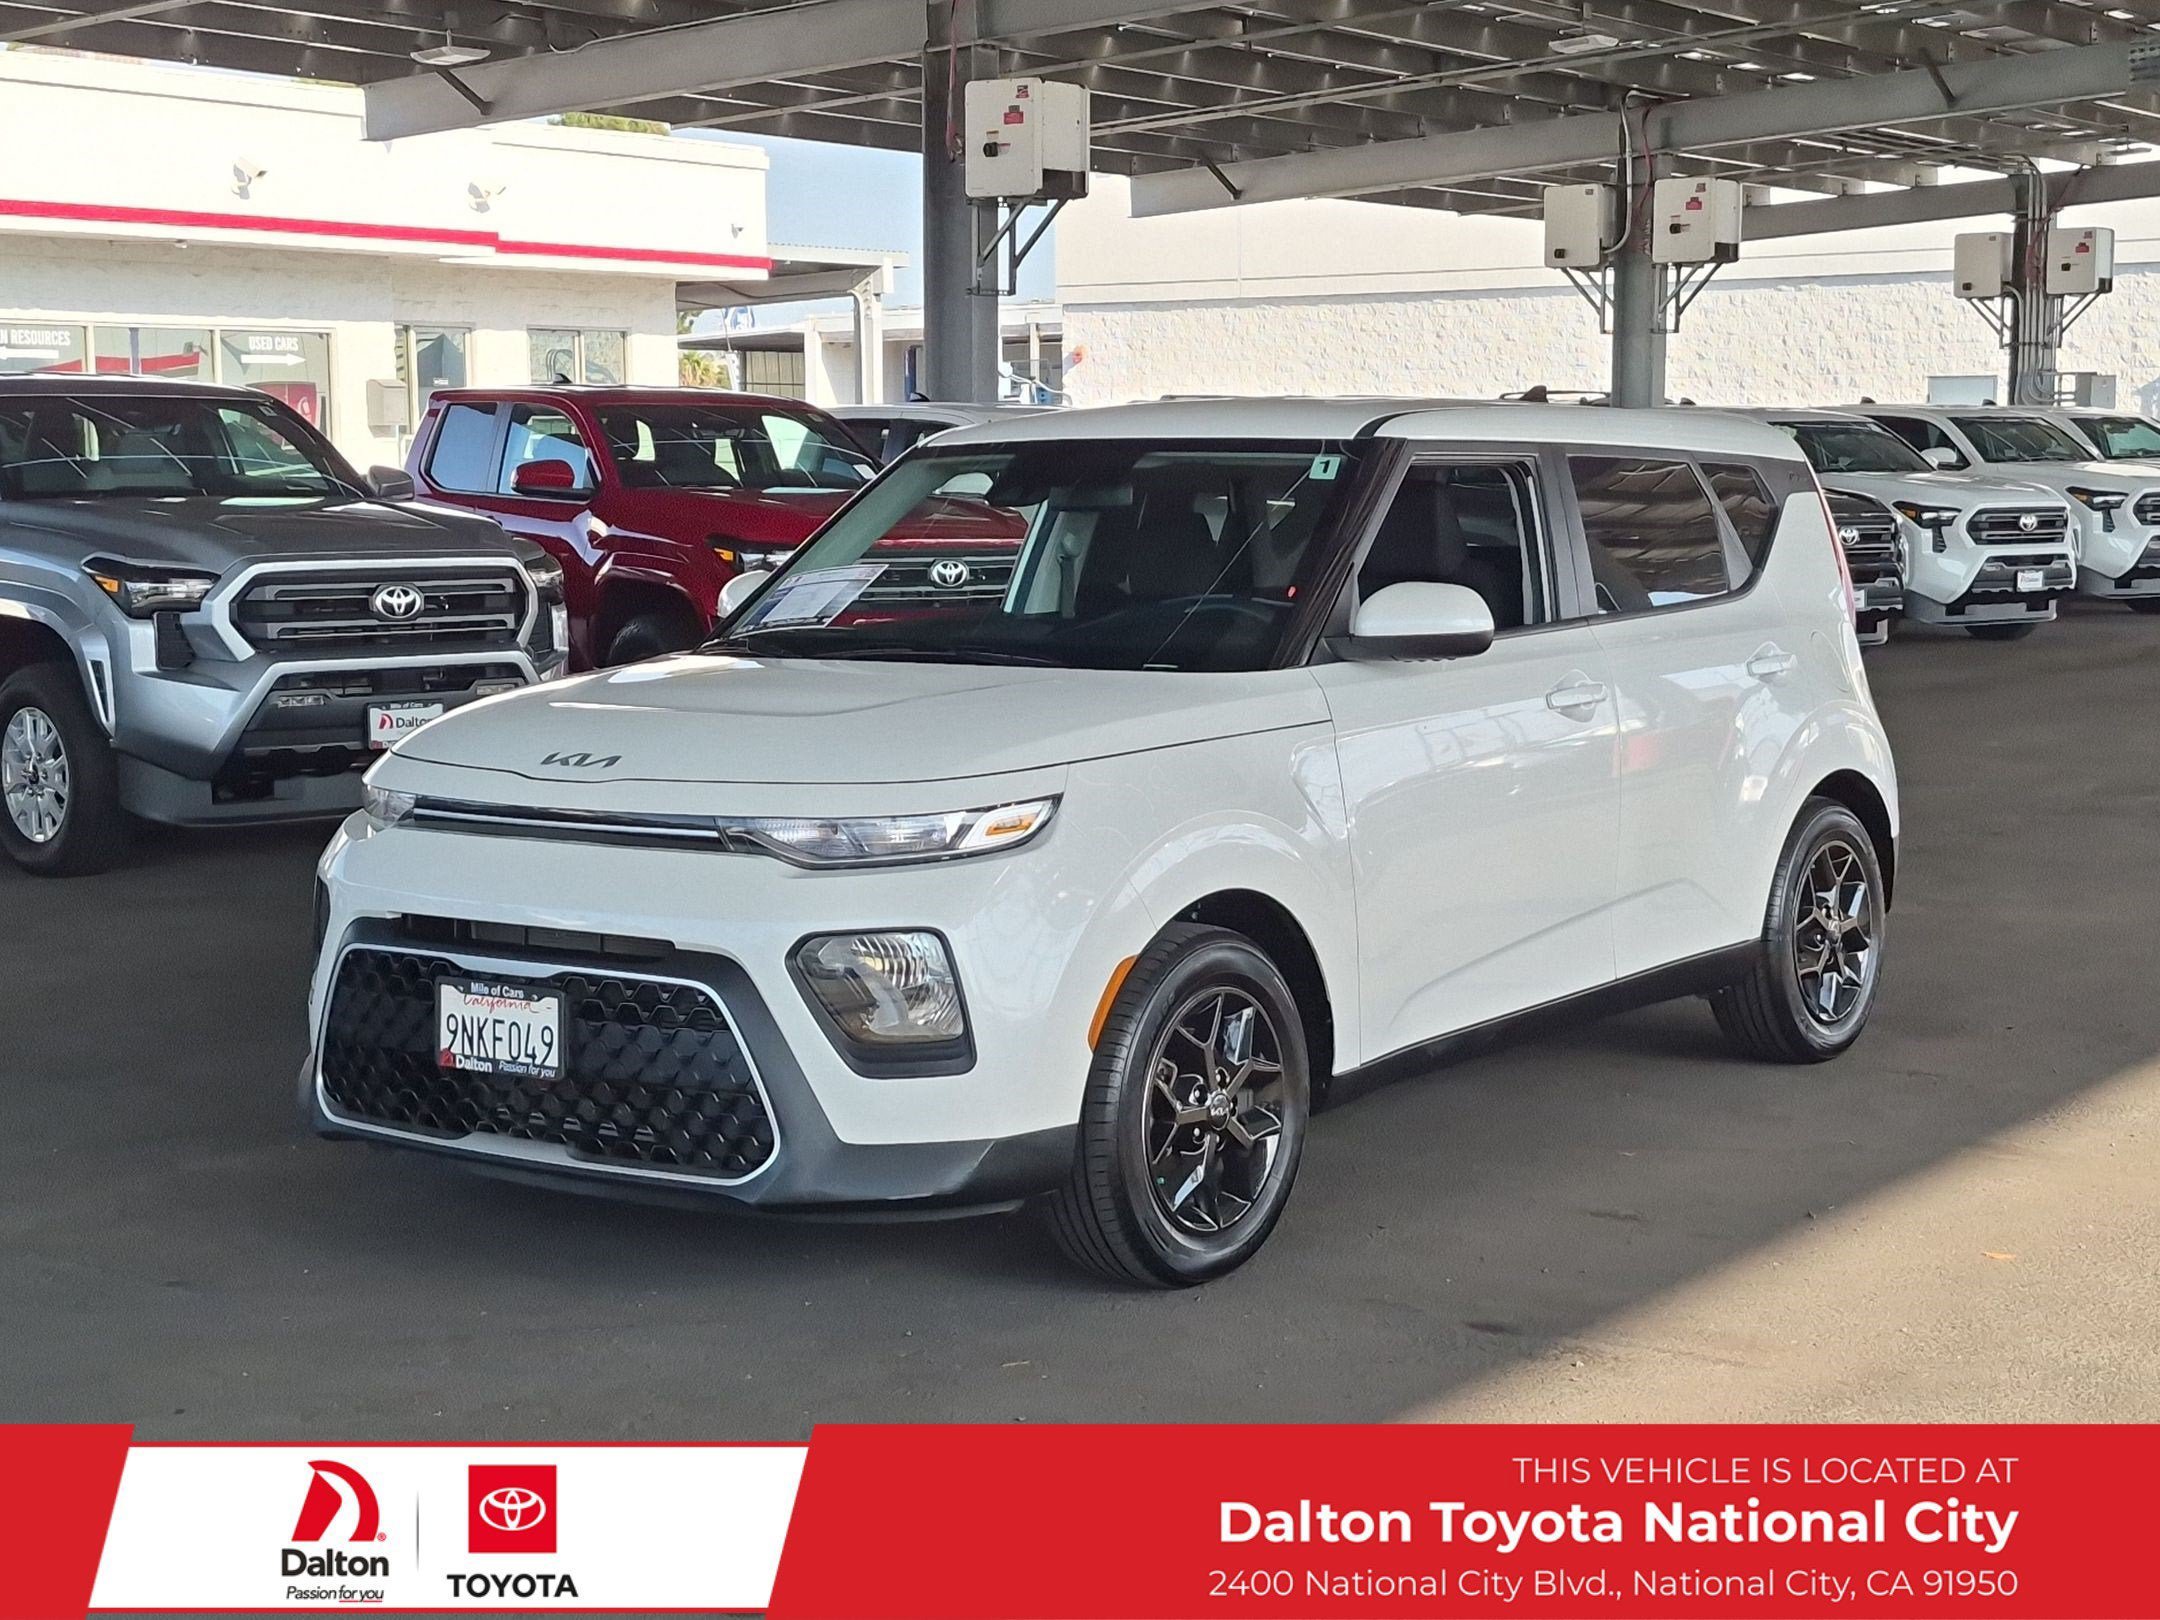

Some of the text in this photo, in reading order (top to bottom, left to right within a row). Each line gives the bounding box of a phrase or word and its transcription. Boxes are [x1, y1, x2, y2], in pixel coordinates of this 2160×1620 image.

[10, 328, 71, 346] RESOURCES
[248, 335, 299, 352] USED CARS
[1319, 459, 1331, 474] 1
[540, 751, 622, 768] KIA
[470, 981, 525, 999] Mile of Cars
[446, 1013, 554, 1066] 9NKF049
[455, 1055, 556, 1079] Dalton Passion for you
